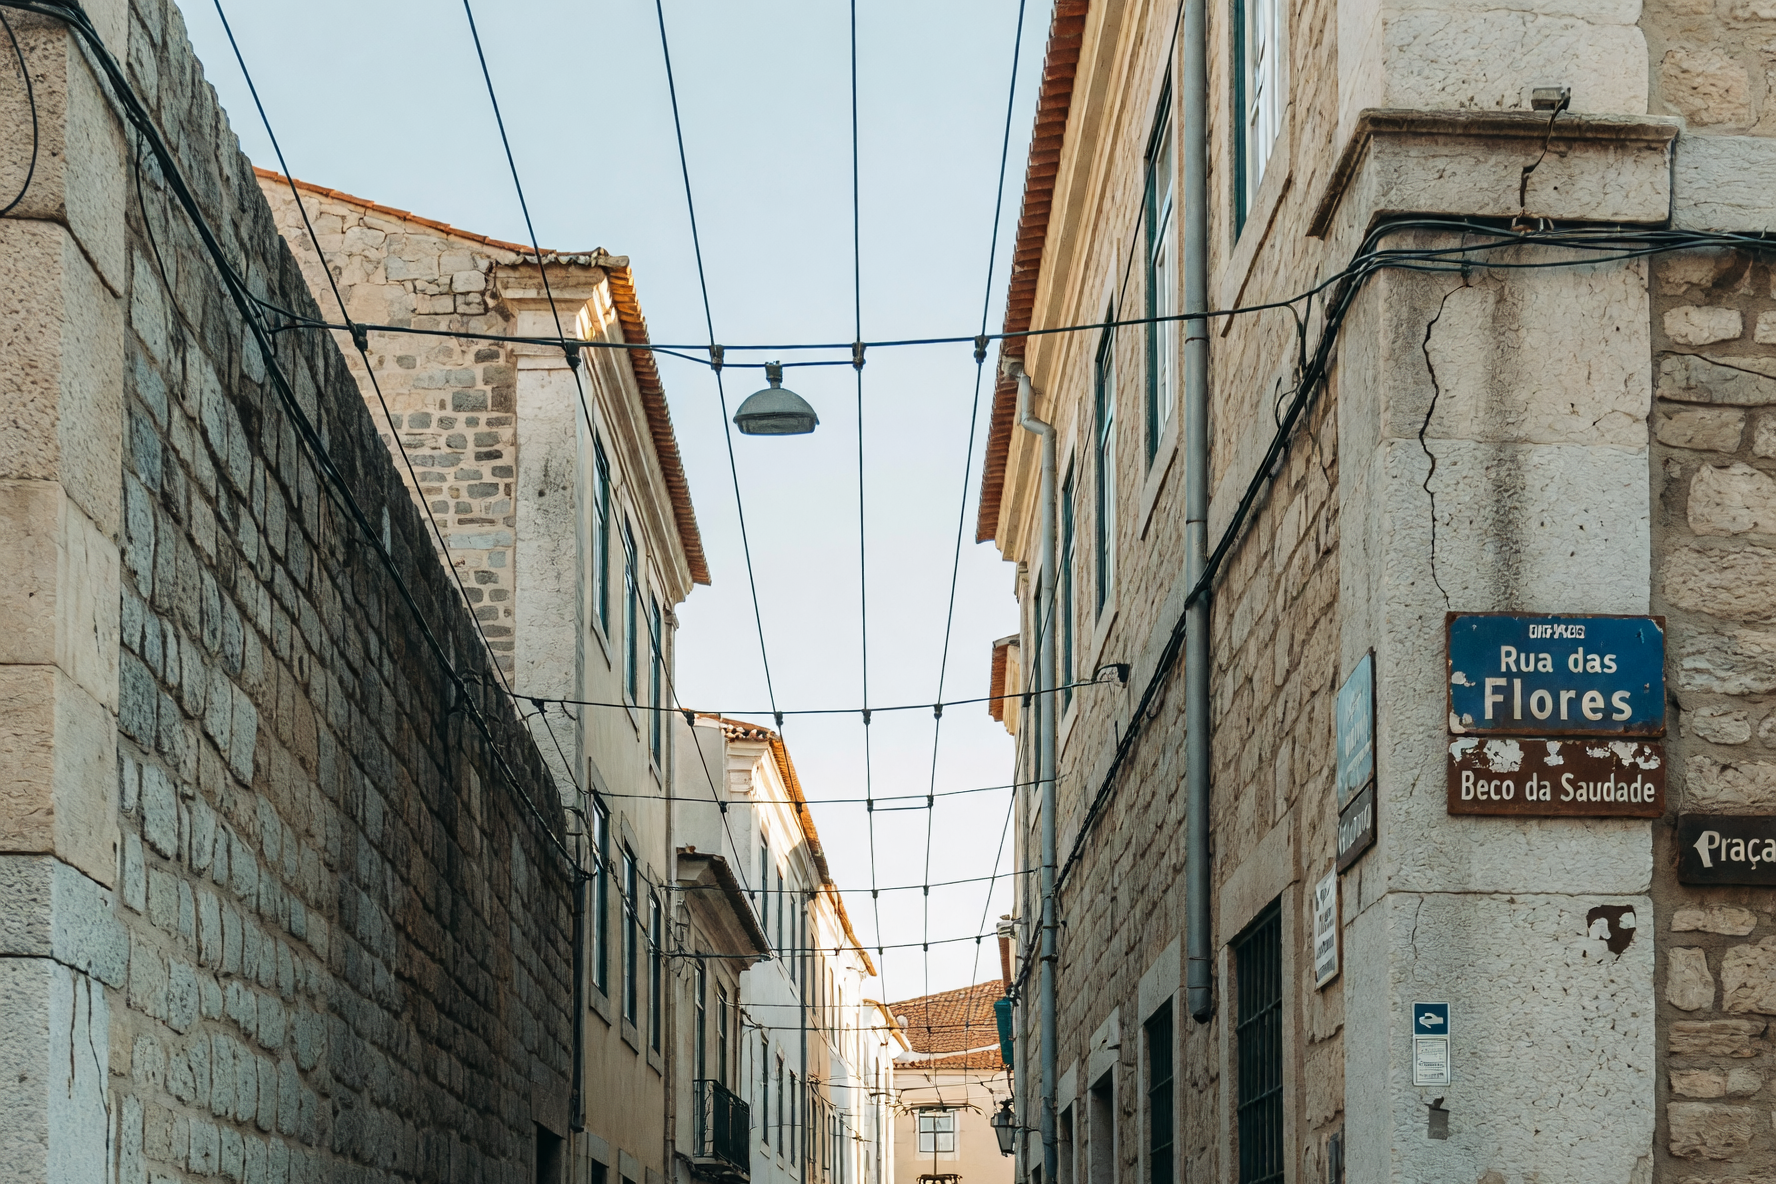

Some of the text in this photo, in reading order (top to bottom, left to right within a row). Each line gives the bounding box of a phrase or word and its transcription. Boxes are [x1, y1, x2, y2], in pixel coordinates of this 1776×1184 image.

[1500, 645, 1617, 673] Rua das
[1484, 677, 1632, 721] Flores
[1461, 770, 1655, 803] Beco da Saudade
[1693, 830, 1776, 870] Praça
